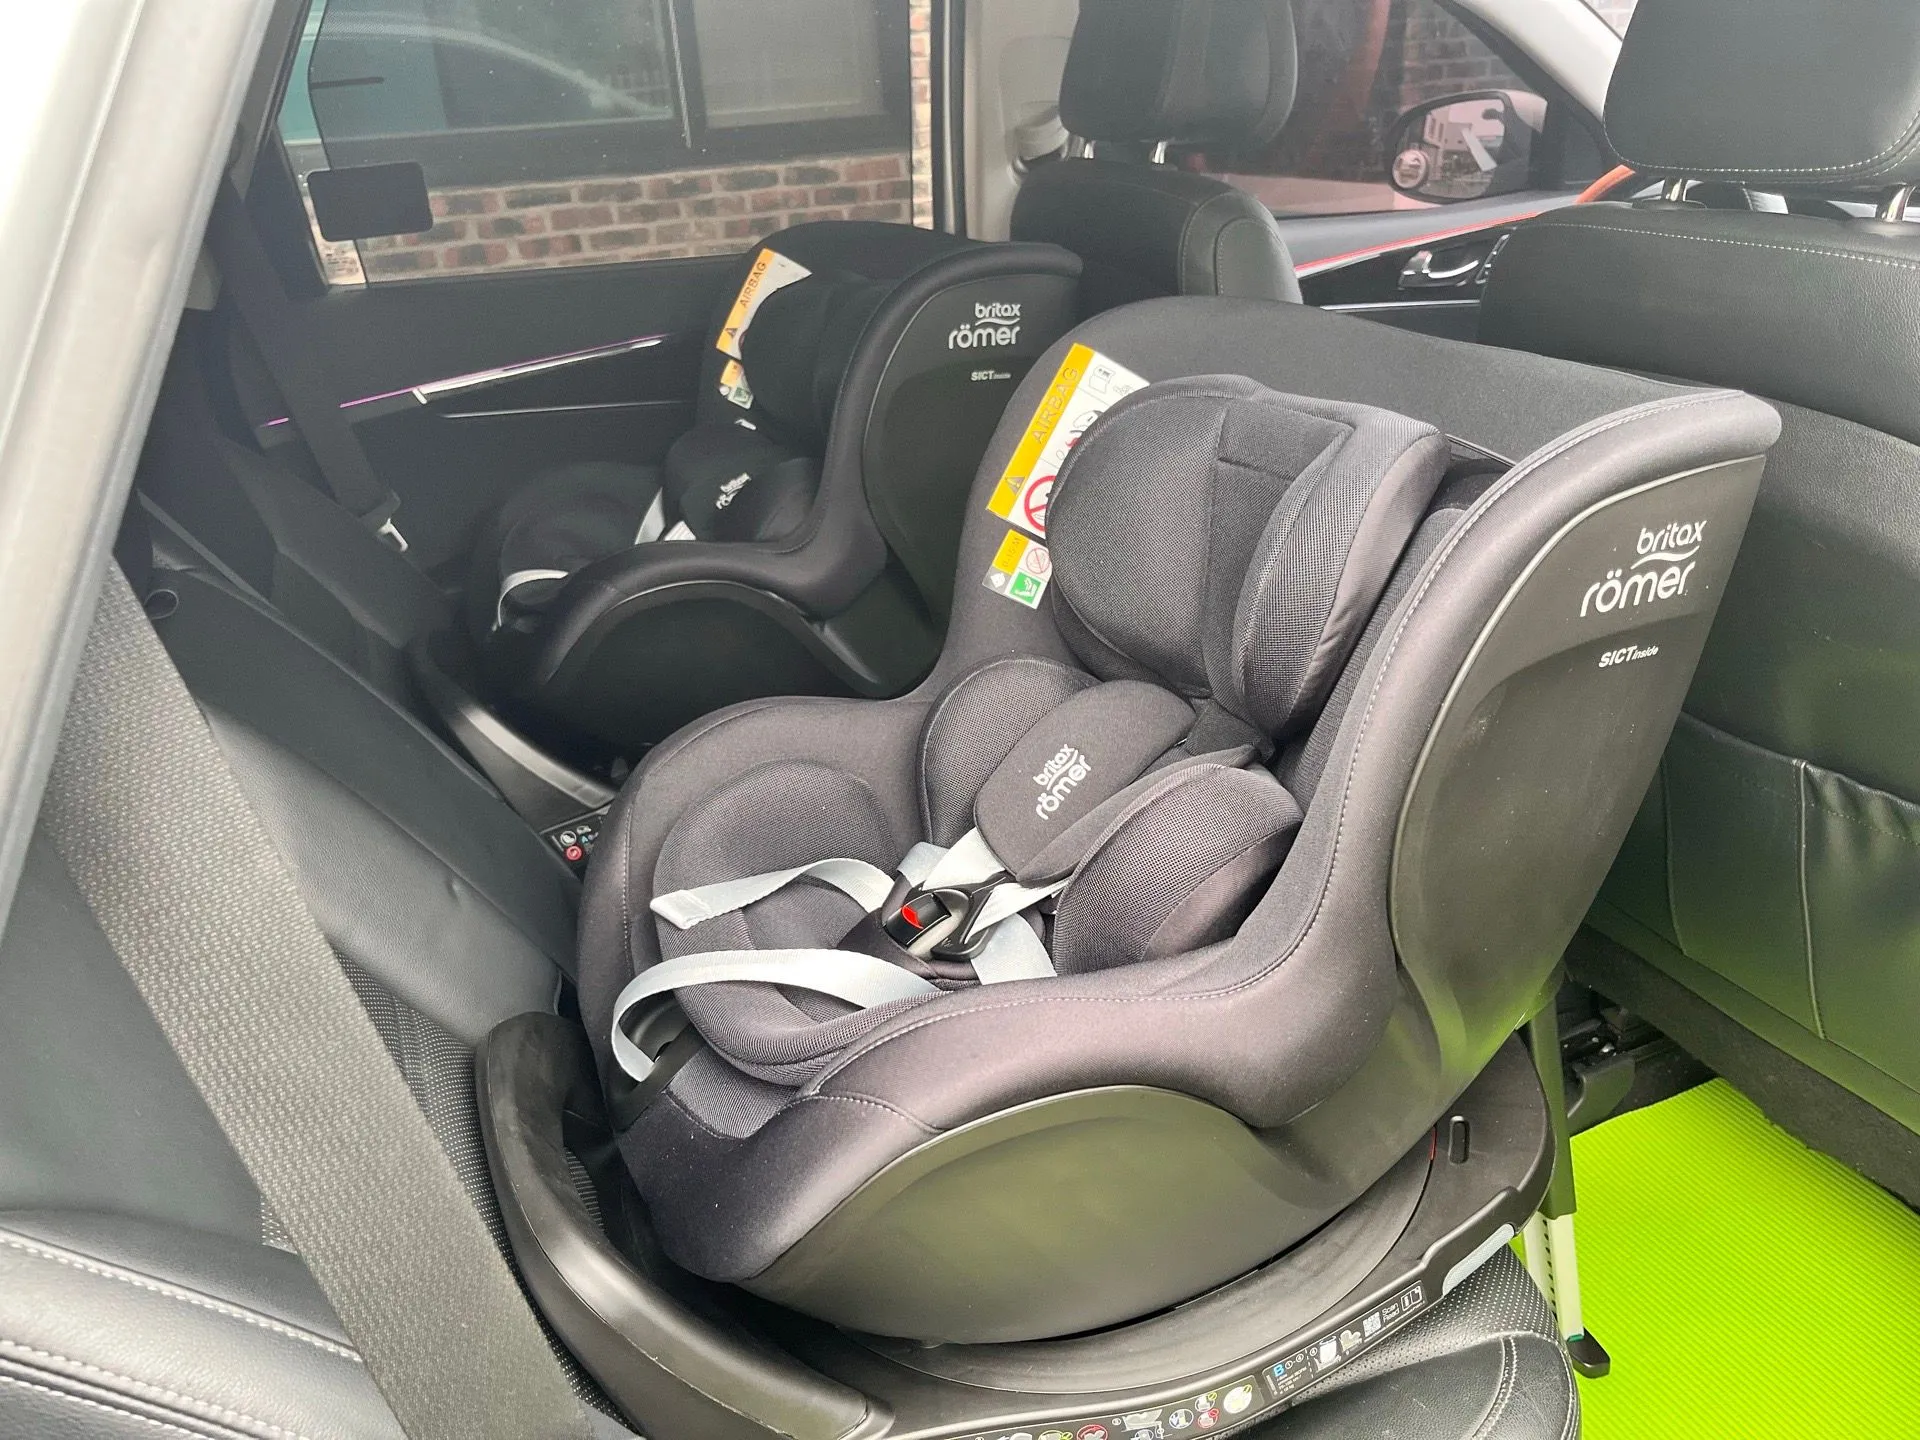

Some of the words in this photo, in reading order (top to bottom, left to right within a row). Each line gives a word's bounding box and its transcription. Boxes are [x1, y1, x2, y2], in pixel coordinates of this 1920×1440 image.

[740, 262, 767, 308] AIRBAG
[974, 302, 1021, 318] britax
[948, 324, 1020, 349] römer
[1031, 367, 1079, 445] AIRBAG
[1637, 520, 1707, 554] britax
[1580, 561, 1696, 617] römer
[1033, 744, 1075, 786] britax
[1036, 755, 1092, 820] römer
